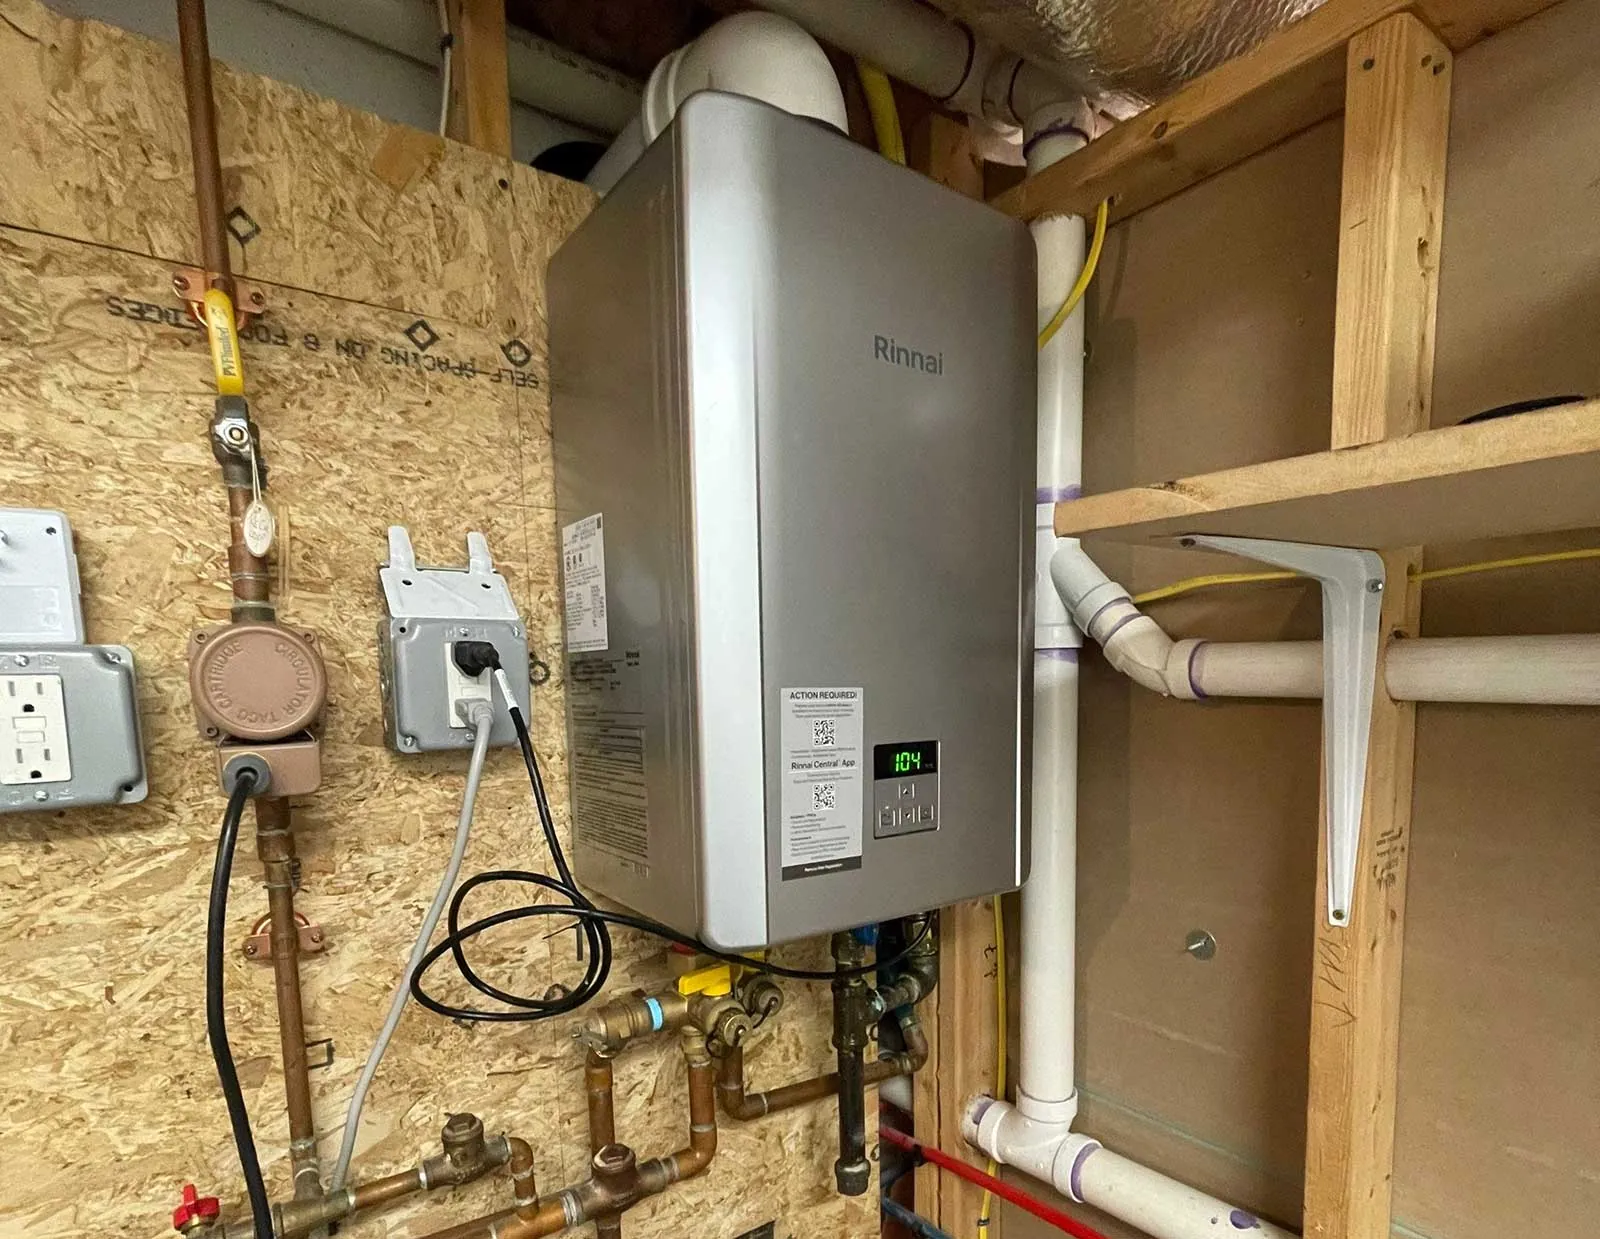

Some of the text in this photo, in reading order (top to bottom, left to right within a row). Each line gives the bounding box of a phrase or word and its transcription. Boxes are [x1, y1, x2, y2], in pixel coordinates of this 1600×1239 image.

[335, 338, 366, 360] ON
[874, 334, 943, 376] Rinnai
[380, 347, 477, 380] SPACING
[489, 368, 540, 389] SELF
[236, 709, 280, 723] TACO
[275, 643, 312, 715] CIRCULATOR
[790, 691, 857, 700] ACTION REQUIRED!
[791, 761, 813, 770] Rinnai
[842, 759, 856, 767] App
[895, 751, 921, 772] 104
